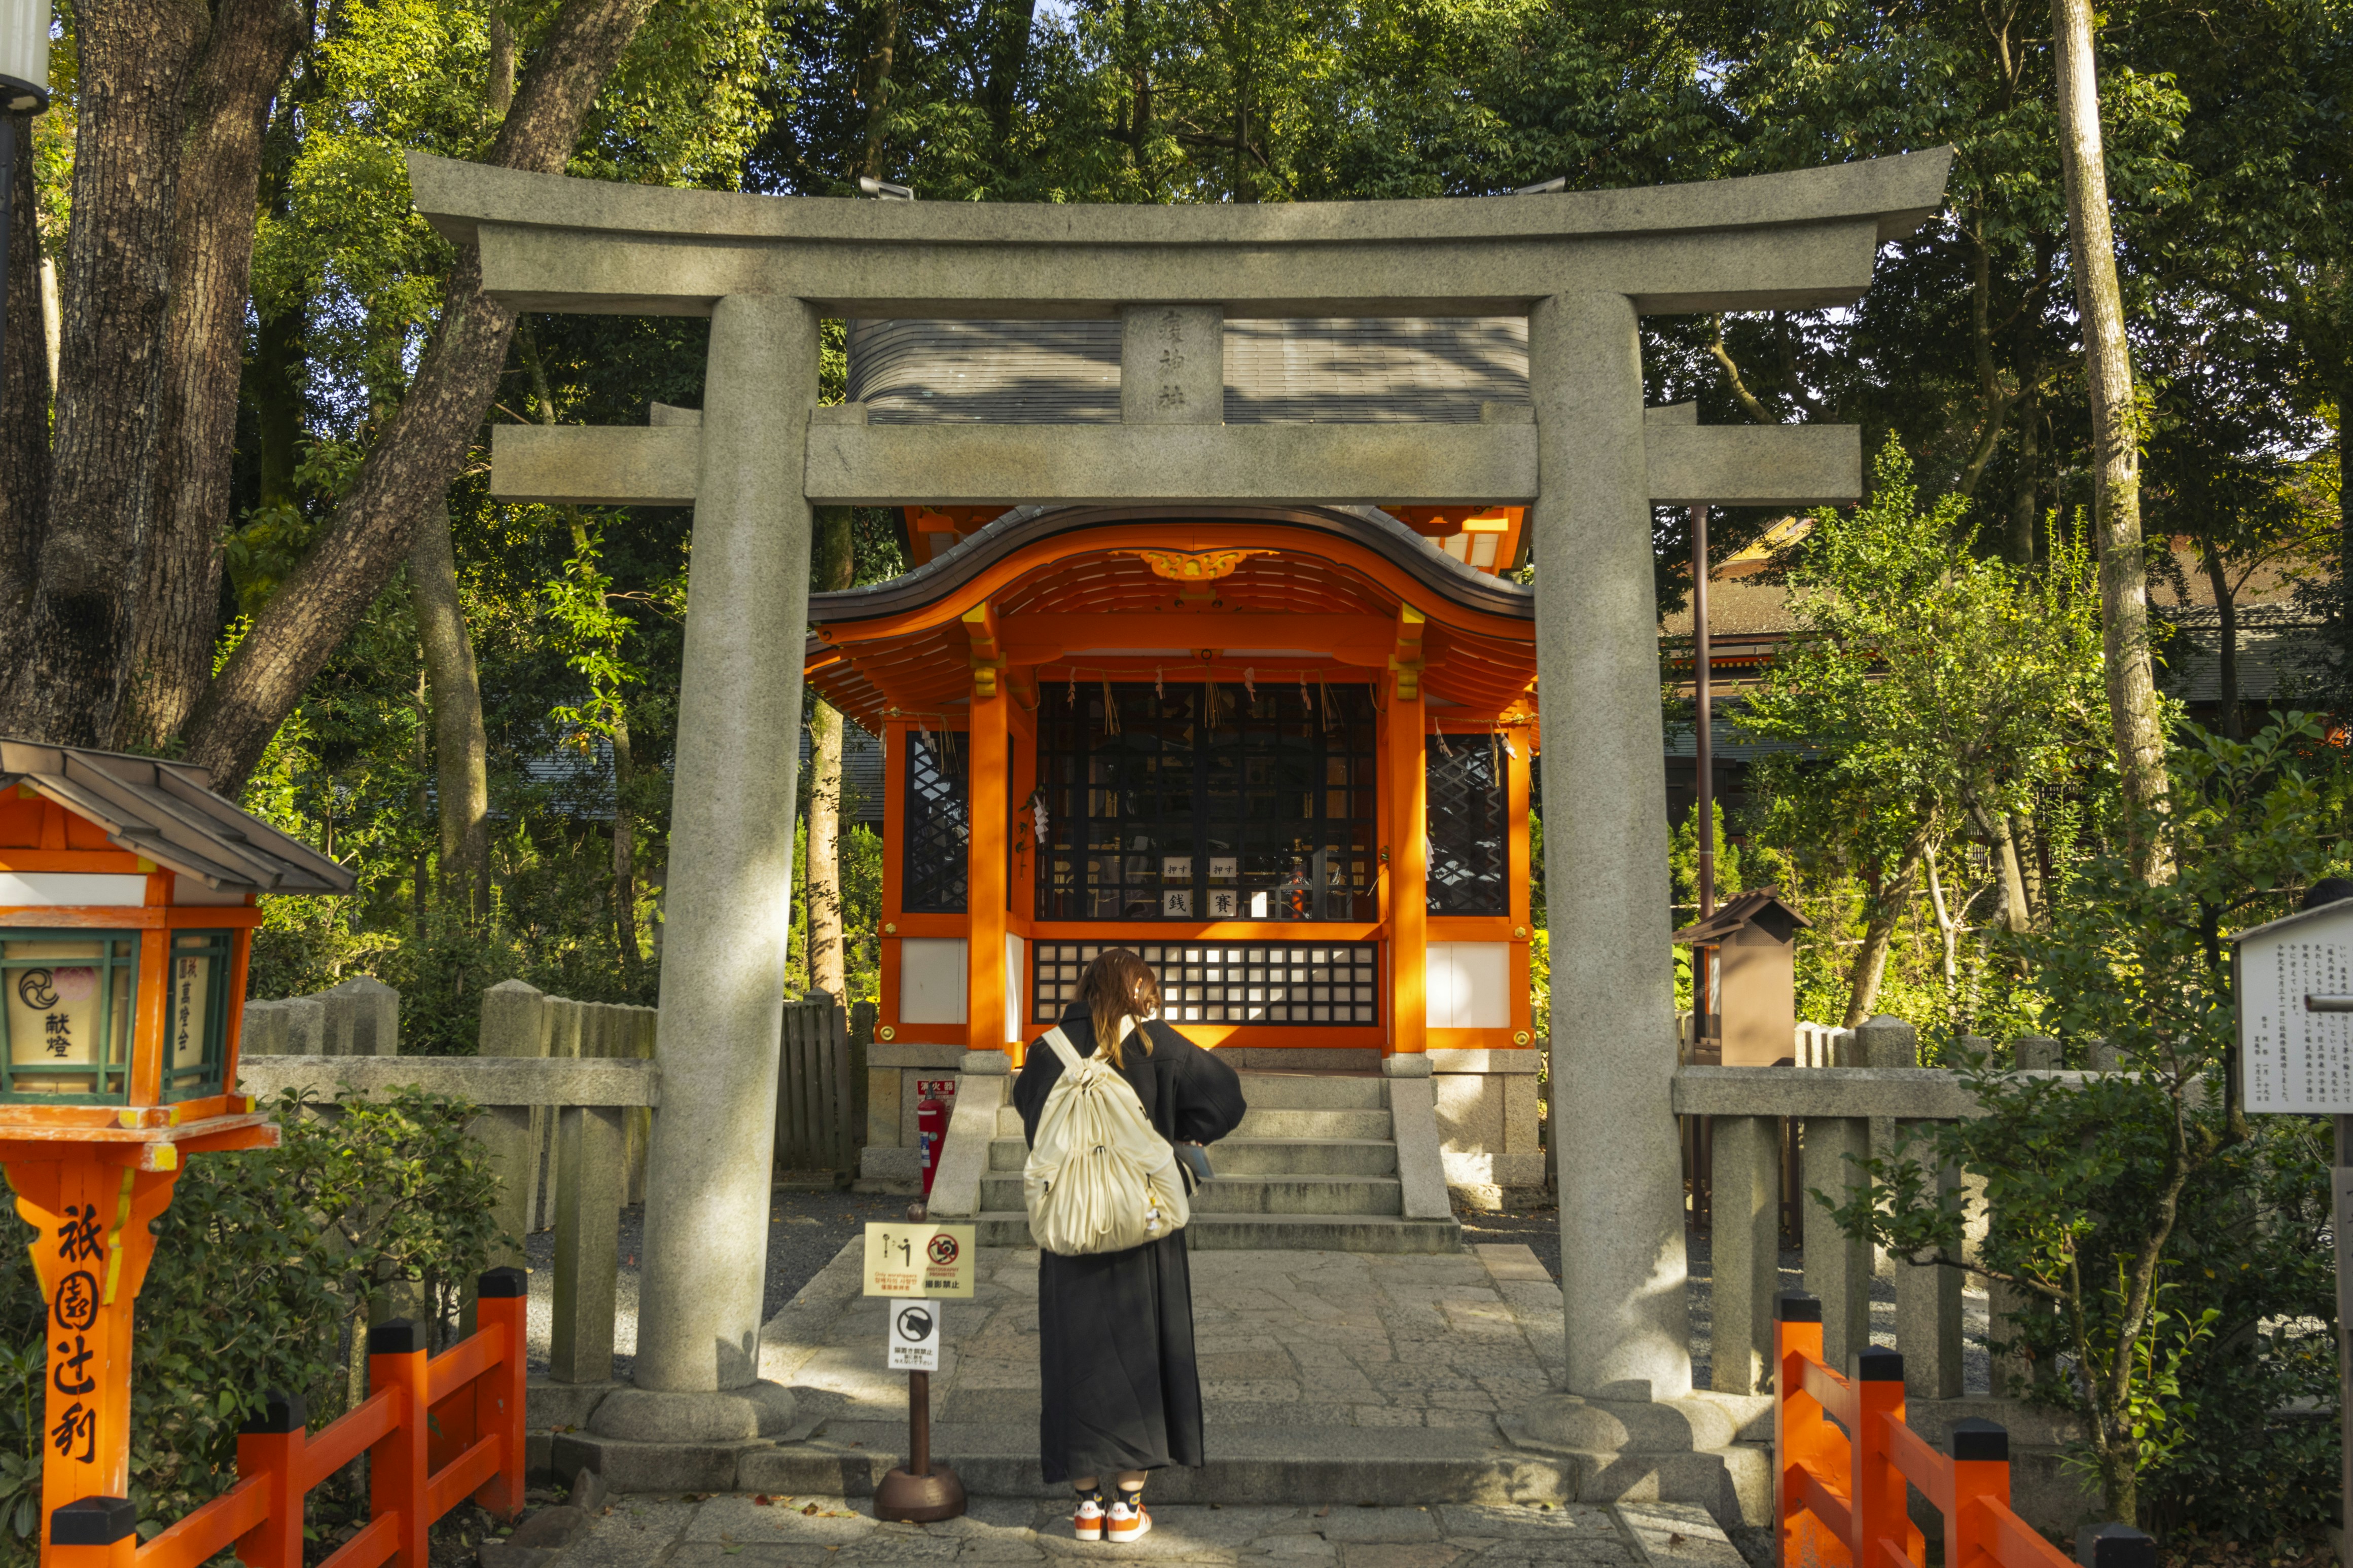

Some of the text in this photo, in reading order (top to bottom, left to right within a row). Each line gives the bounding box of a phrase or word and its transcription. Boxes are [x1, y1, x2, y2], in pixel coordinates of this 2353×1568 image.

[1157, 310, 1185, 407] 疫神社
[1168, 865, 1187, 874] 押す
[1214, 865, 1233, 874] 押す
[1168, 894, 1186, 912] 銭
[1215, 894, 1232, 913] 賽
[925, 1280, 959, 1289] 撮影禁止
[51, 1204, 103, 1464] 祇園辻利
